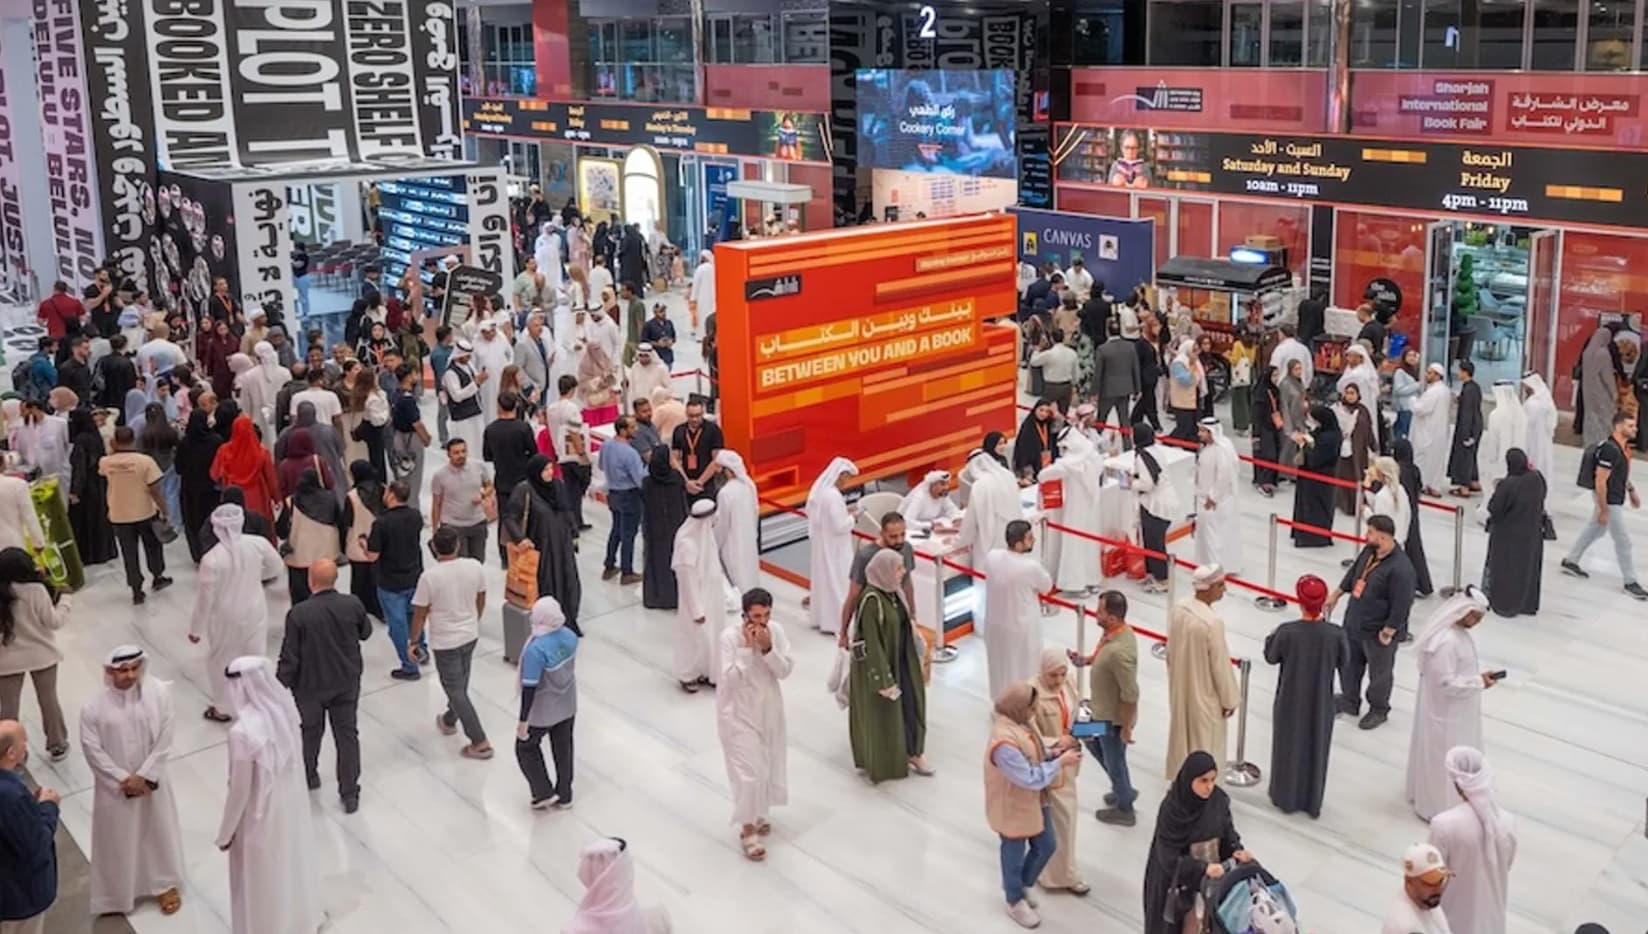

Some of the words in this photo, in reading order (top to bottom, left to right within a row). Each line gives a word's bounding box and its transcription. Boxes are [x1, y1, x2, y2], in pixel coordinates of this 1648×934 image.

[347, 0, 408, 66] ZERO
[919, 6, 937, 38] 2
[52, 0, 78, 78] FIVE
[152, 0, 225, 123] BOOKED
[234, 0, 343, 111] PLOT
[1435, 81, 1490, 95] Sharjah
[352, 72, 417, 148] SHELF
[1401, 98, 1489, 113] International
[1511, 95, 1577, 112] الشارقة
[1578, 99, 1630, 114] معرض
[899, 121, 935, 137] Cookery
[1423, 116, 1458, 129] Book
[1460, 117, 1488, 130] Fair
[60, 88, 90, 217] STARS,
[165, 130, 233, 171] AN
[1462, 150, 1513, 168] الجمعة
[1222, 158, 1275, 177] Saturday
[1277, 161, 1301, 175] and
[1302, 162, 1351, 182] Sunday
[1245, 180, 1279, 192] 10am
[1287, 183, 1319, 197] 11pm
[1460, 172, 1511, 193] Friday
[1441, 193, 1478, 211] 4pm
[1488, 197, 1529, 214] 11pm
[1043, 227, 1092, 249] CANVAS
[759, 320, 860, 358] الكتاب
[761, 356, 847, 387] BETWEEN
[848, 347, 880, 368] YOU
[882, 340, 918, 360] AND
[918, 337, 931, 353] A
[932, 327, 973, 348] BOOK
